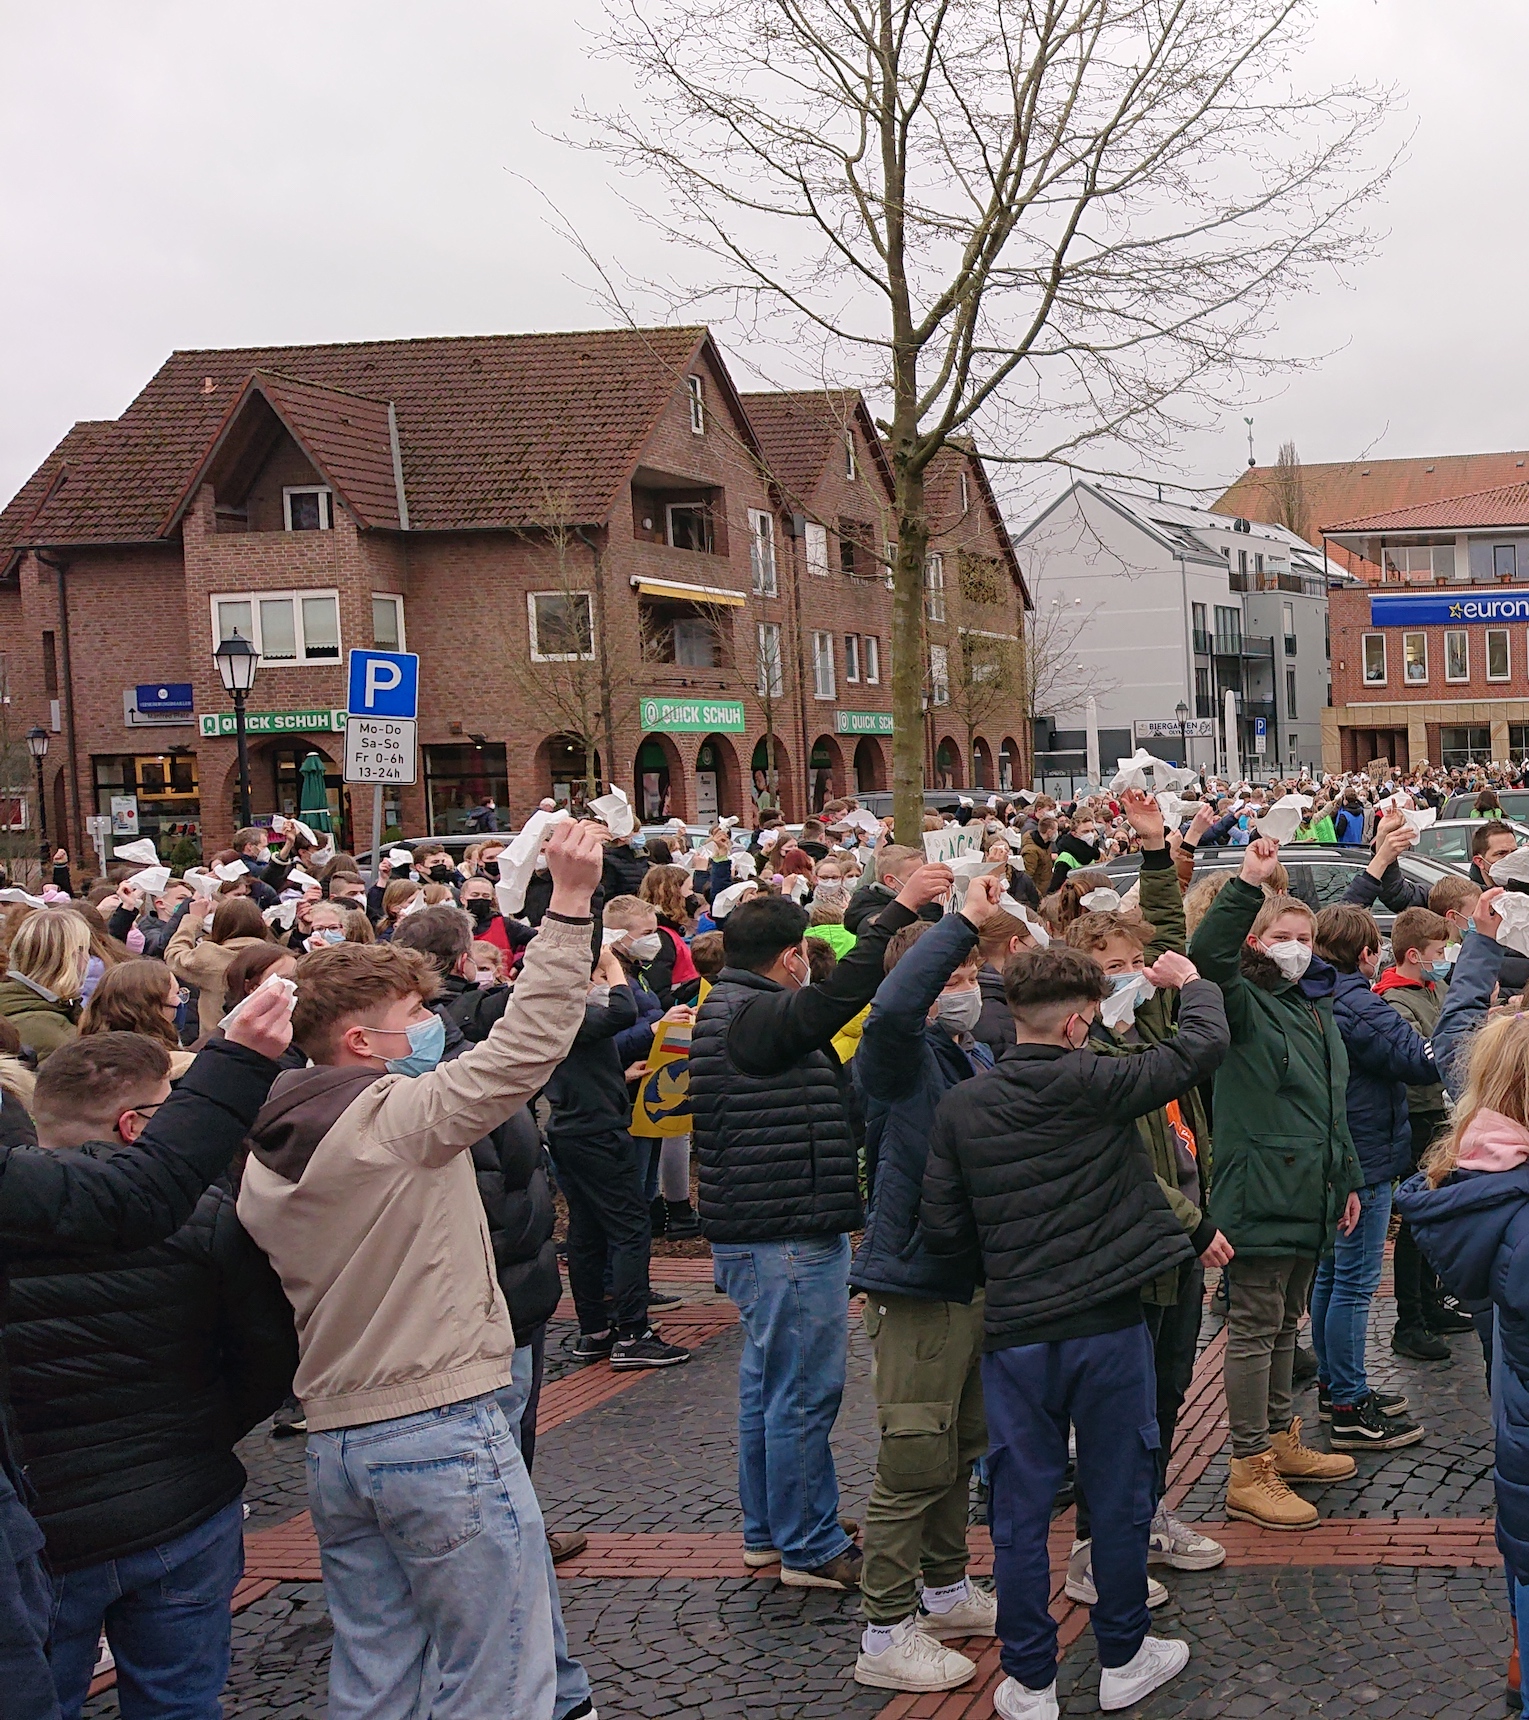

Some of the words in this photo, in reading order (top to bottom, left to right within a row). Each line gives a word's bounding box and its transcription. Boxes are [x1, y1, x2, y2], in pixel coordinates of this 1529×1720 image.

[364, 658, 402, 708] P
[662, 704, 700, 724] QUICK
[703, 706, 741, 724] SCHUH
[274, 714, 329, 729] SCHUH
[852, 714, 876, 730] QUICK
[878, 716, 894, 730] SCH
[1149, 722, 1198, 730] BIERGAEN
[1257, 720, 1264, 734] P
[359, 723, 402, 735] Mo-Do
[361, 738, 400, 749] Sa-So
[355, 752, 369, 763] Fr
[375, 753, 404, 764] 0-6h
[359, 767, 400, 778] 13-24h
